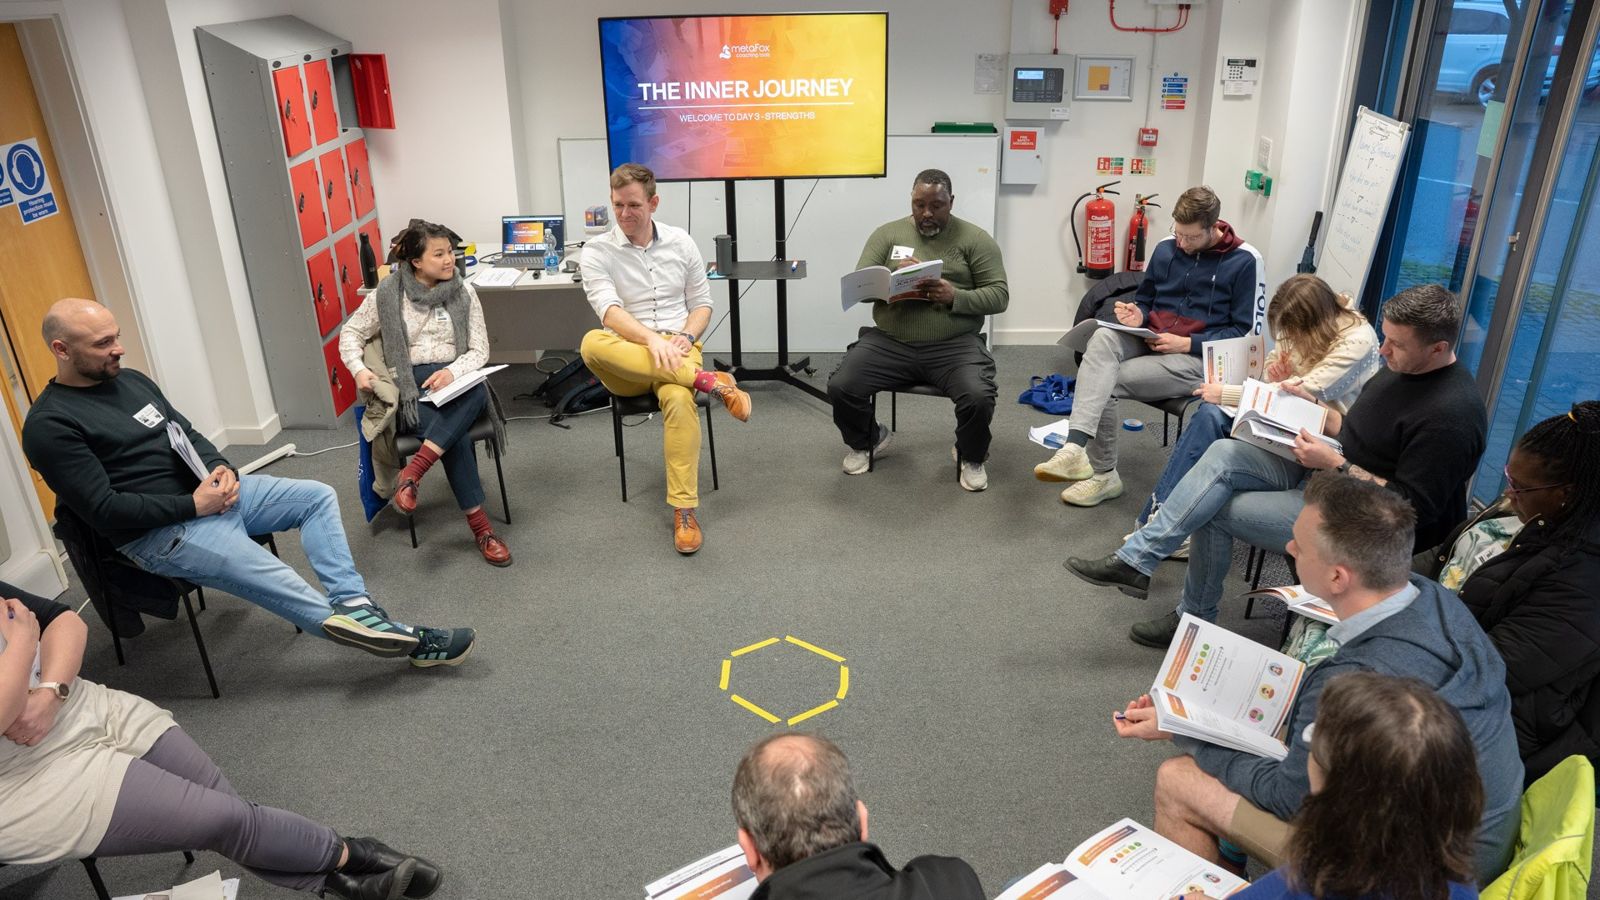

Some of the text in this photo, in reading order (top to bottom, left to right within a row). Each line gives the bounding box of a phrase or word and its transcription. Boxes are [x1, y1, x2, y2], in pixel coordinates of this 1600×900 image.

[731, 44, 770, 52] metaFox
[638, 78, 853, 100] THE INNER JOURNEY
[680, 114, 722, 122] WELCOME
[724, 113, 736, 122] TO
[736, 112, 753, 121] DAY
[754, 112, 760, 120] 3
[764, 112, 816, 120] STRENGTHS
